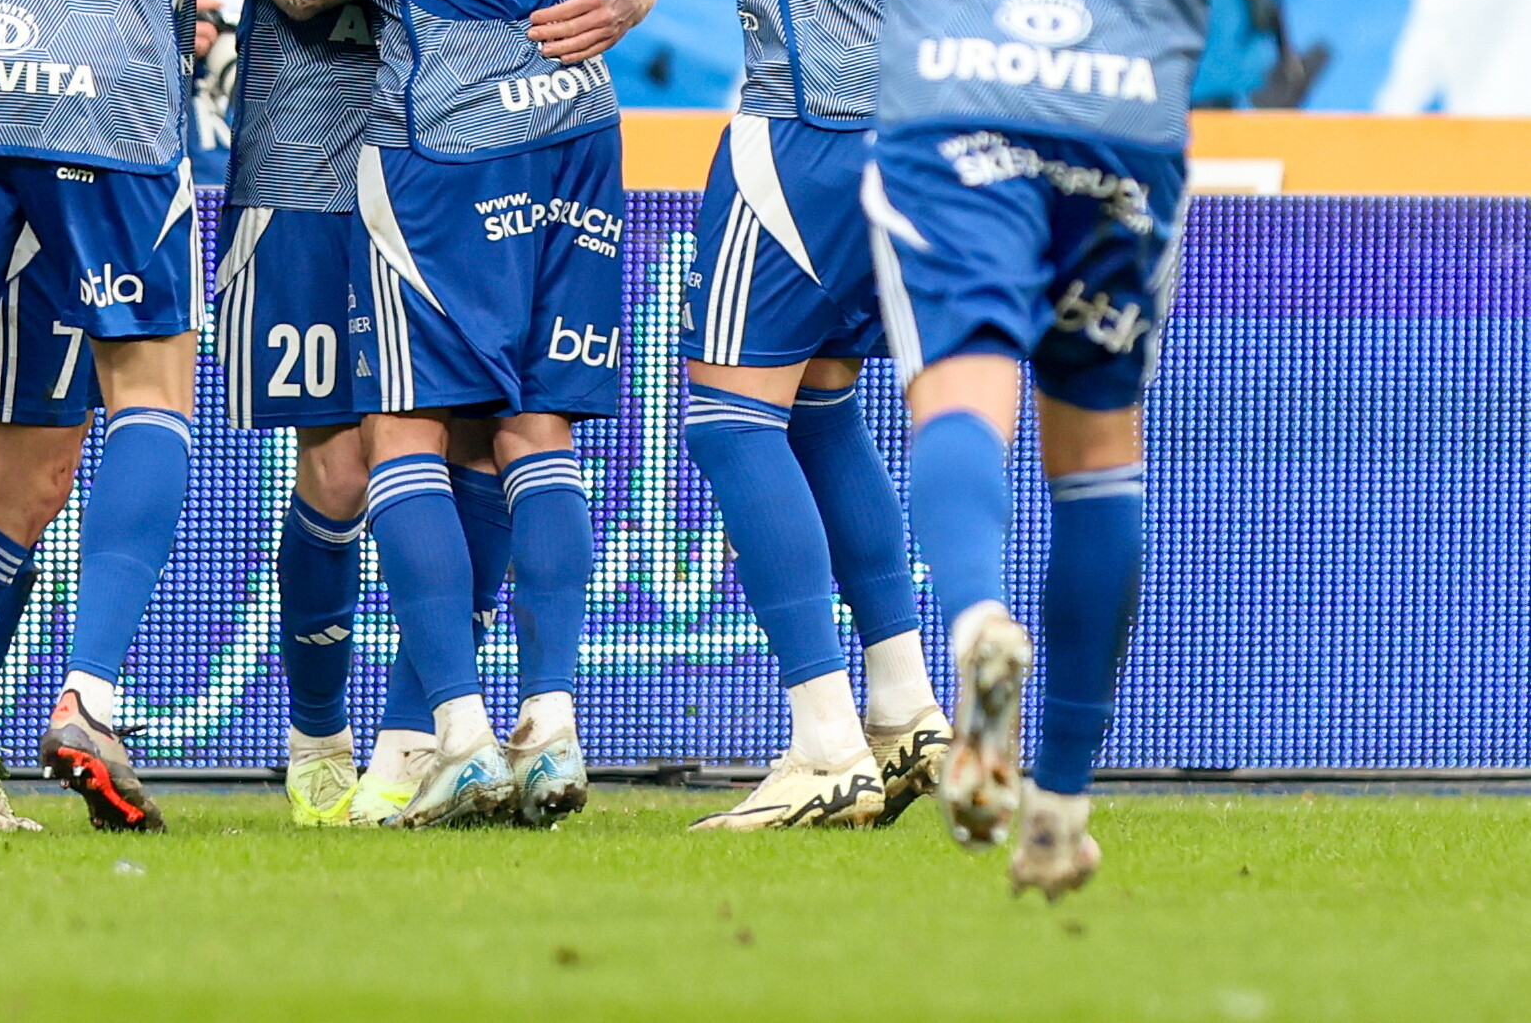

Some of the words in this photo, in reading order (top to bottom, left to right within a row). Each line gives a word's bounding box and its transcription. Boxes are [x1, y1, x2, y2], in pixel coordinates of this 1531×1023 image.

[918, 37, 1157, 103] UROVITA
[475, 192, 531, 214] www.
[574, 234, 617, 258] .com
[52, 321, 83, 399] 7
[268, 323, 337, 398] 20
[548, 316, 620, 368] btl
